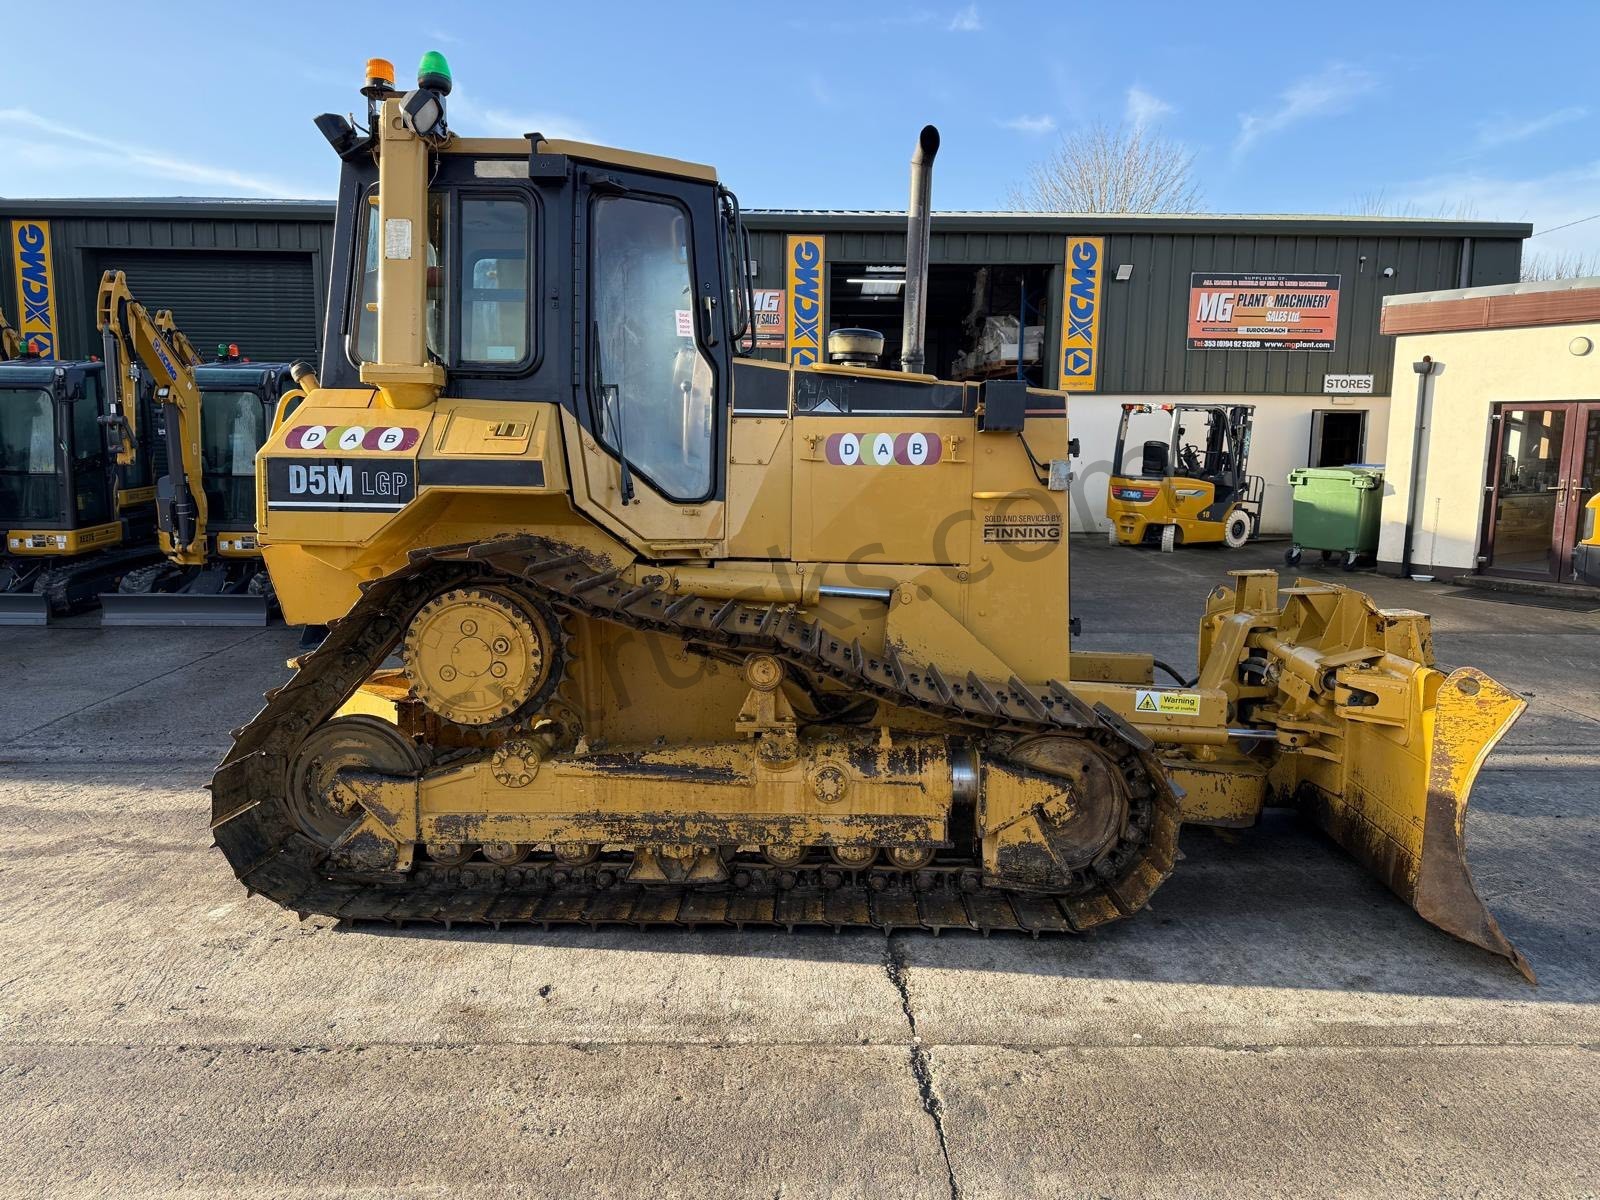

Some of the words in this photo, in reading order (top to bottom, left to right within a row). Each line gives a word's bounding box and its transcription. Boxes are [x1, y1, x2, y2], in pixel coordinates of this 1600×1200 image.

[18, 224, 52, 330] XCMG
[794, 241, 820, 347] XCMG
[1067, 242, 1098, 346] XCMG
[1196, 292, 1235, 323] MG
[761, 313, 780, 325] SALES
[1265, 311, 1288, 322] SALES
[1264, 341, 1331, 349] www.mgplant.com
[1325, 379, 1371, 389] STORES
[288, 464, 353, 495] D5M
[361, 471, 408, 496] LGP
[984, 515, 1002, 523] SOLD
[1003, 515, 1017, 523] AND
[983, 528, 1060, 538] FINNING
[1164, 696, 1194, 705] Warning
